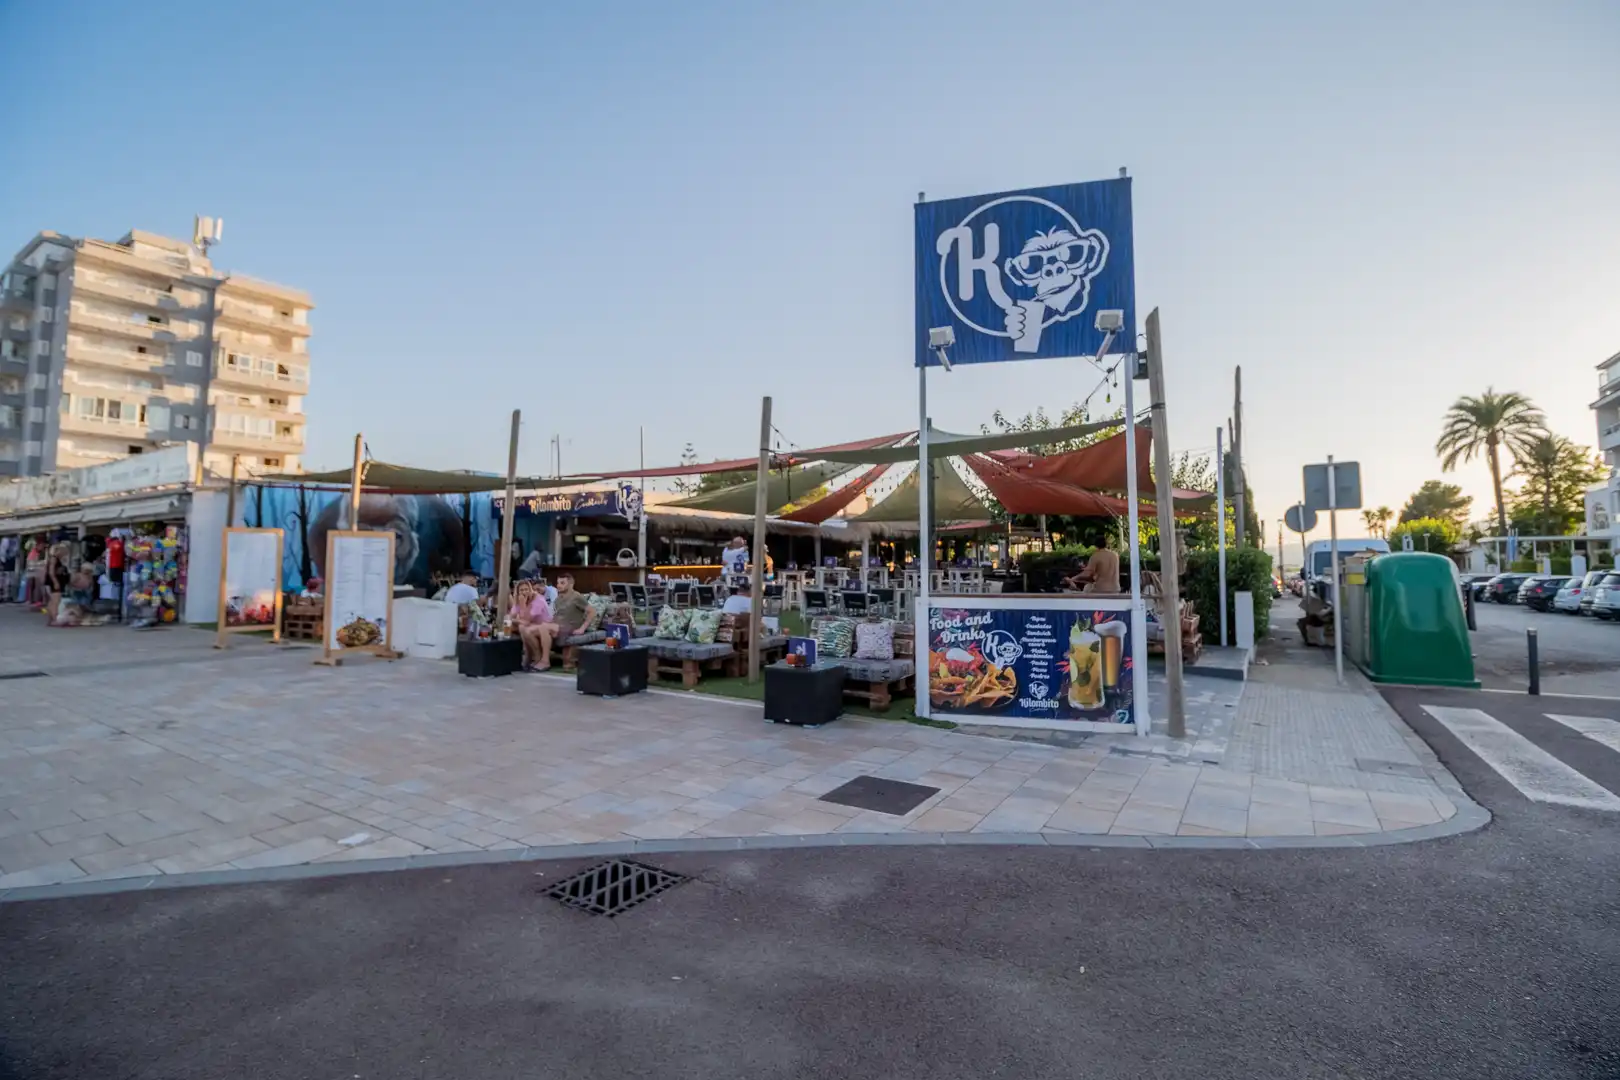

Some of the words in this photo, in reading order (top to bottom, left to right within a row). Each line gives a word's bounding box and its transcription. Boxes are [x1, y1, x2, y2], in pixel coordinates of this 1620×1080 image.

[929, 614, 963, 631] Food
[965, 611, 993, 626] and
[940, 626, 986, 644] Drinks
[1019, 697, 1059, 708] Kilombito
